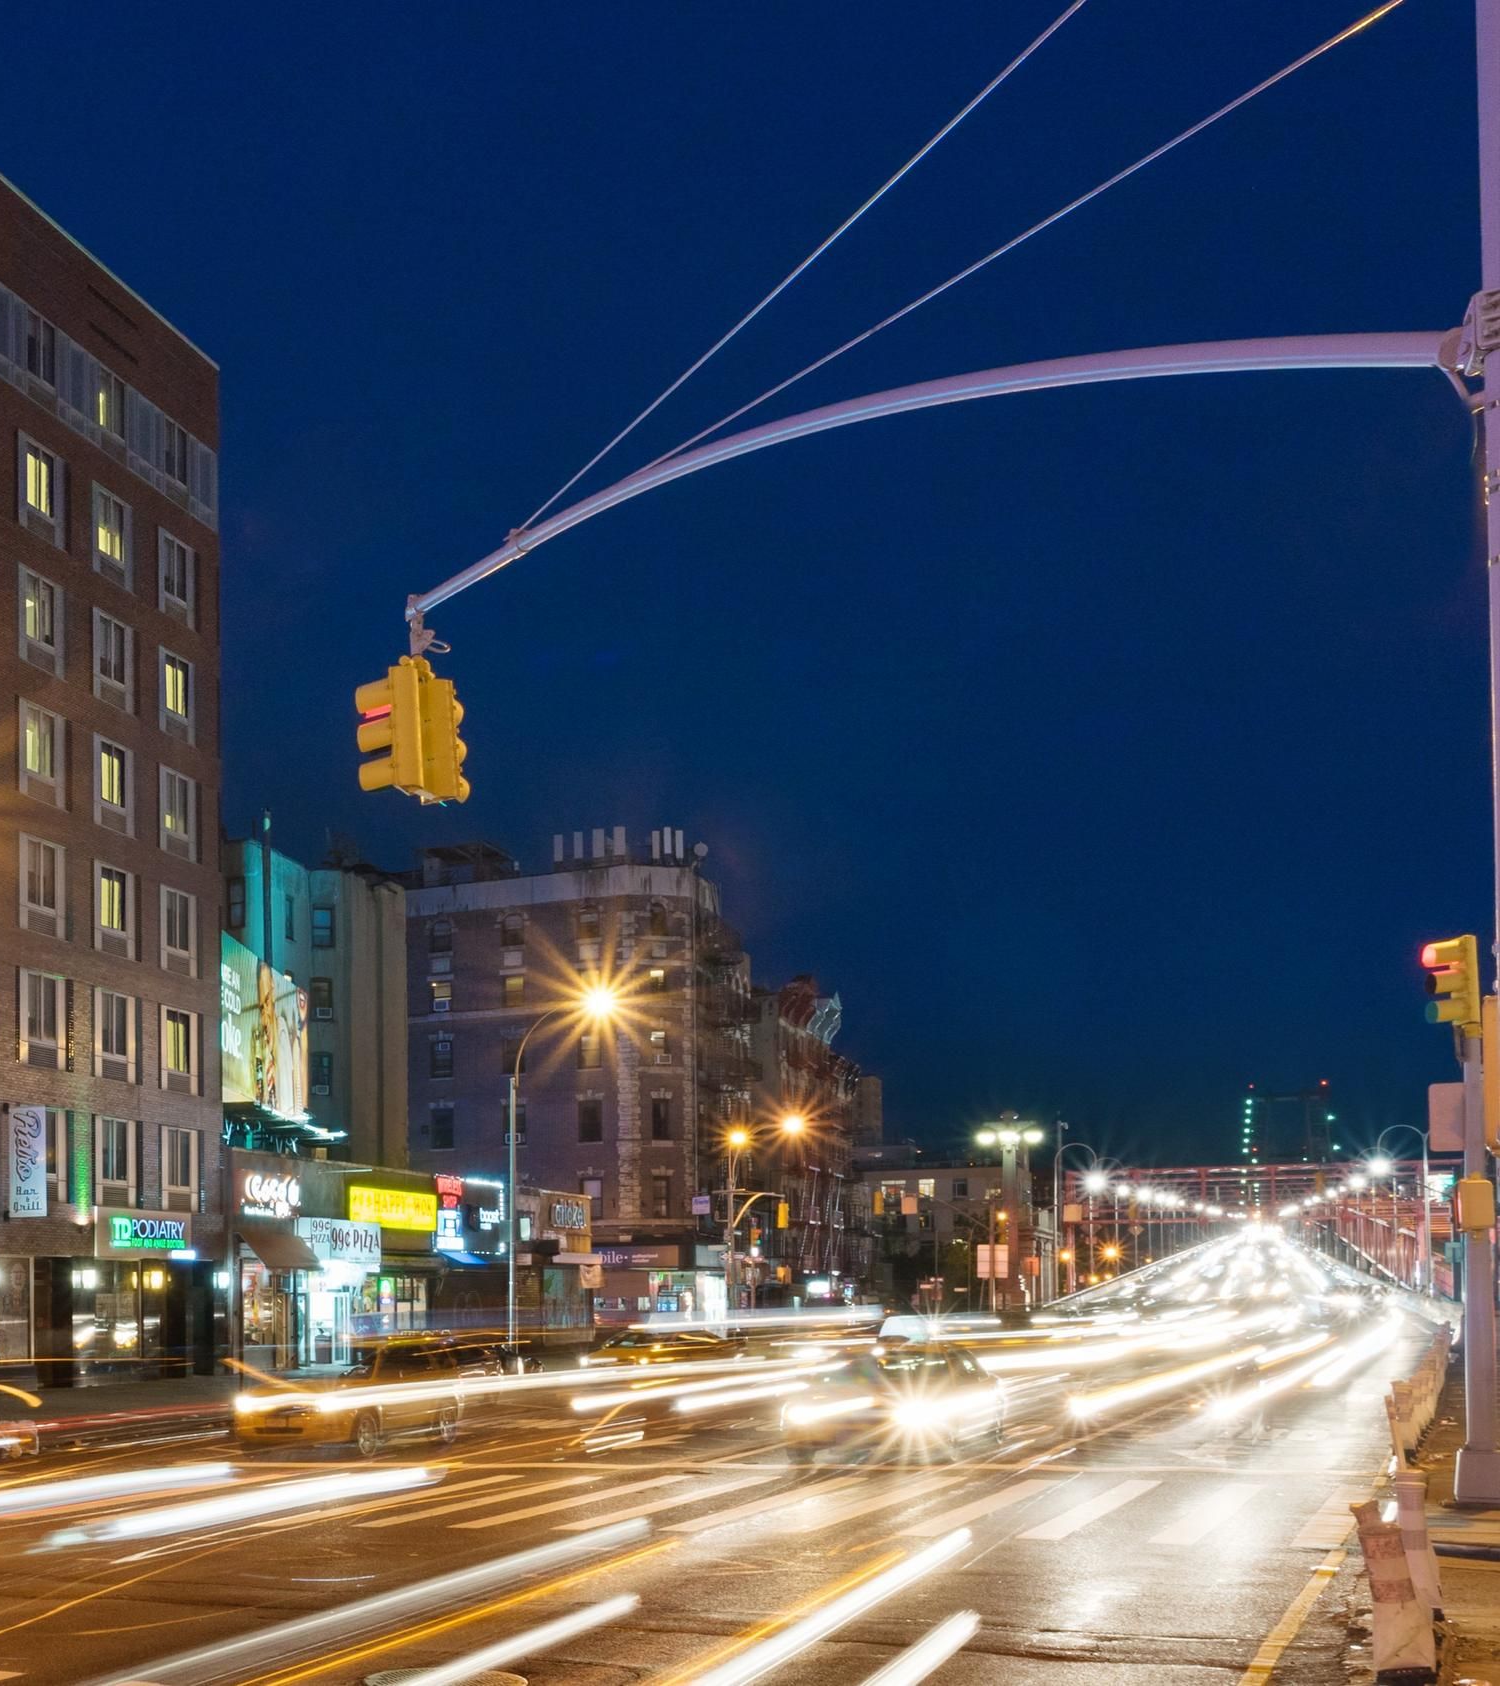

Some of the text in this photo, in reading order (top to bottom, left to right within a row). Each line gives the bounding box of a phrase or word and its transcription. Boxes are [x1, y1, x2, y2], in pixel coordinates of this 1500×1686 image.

[13, 1109, 42, 1182] Retro
[15, 1186, 40, 1195] Bar
[12, 1201, 43, 1213] Grill
[479, 1207, 500, 1224] boost
[132, 1218, 185, 1240] PODIATRY
[311, 1233, 331, 1244] PIZZA
[353, 1229, 380, 1253] PIZZA
